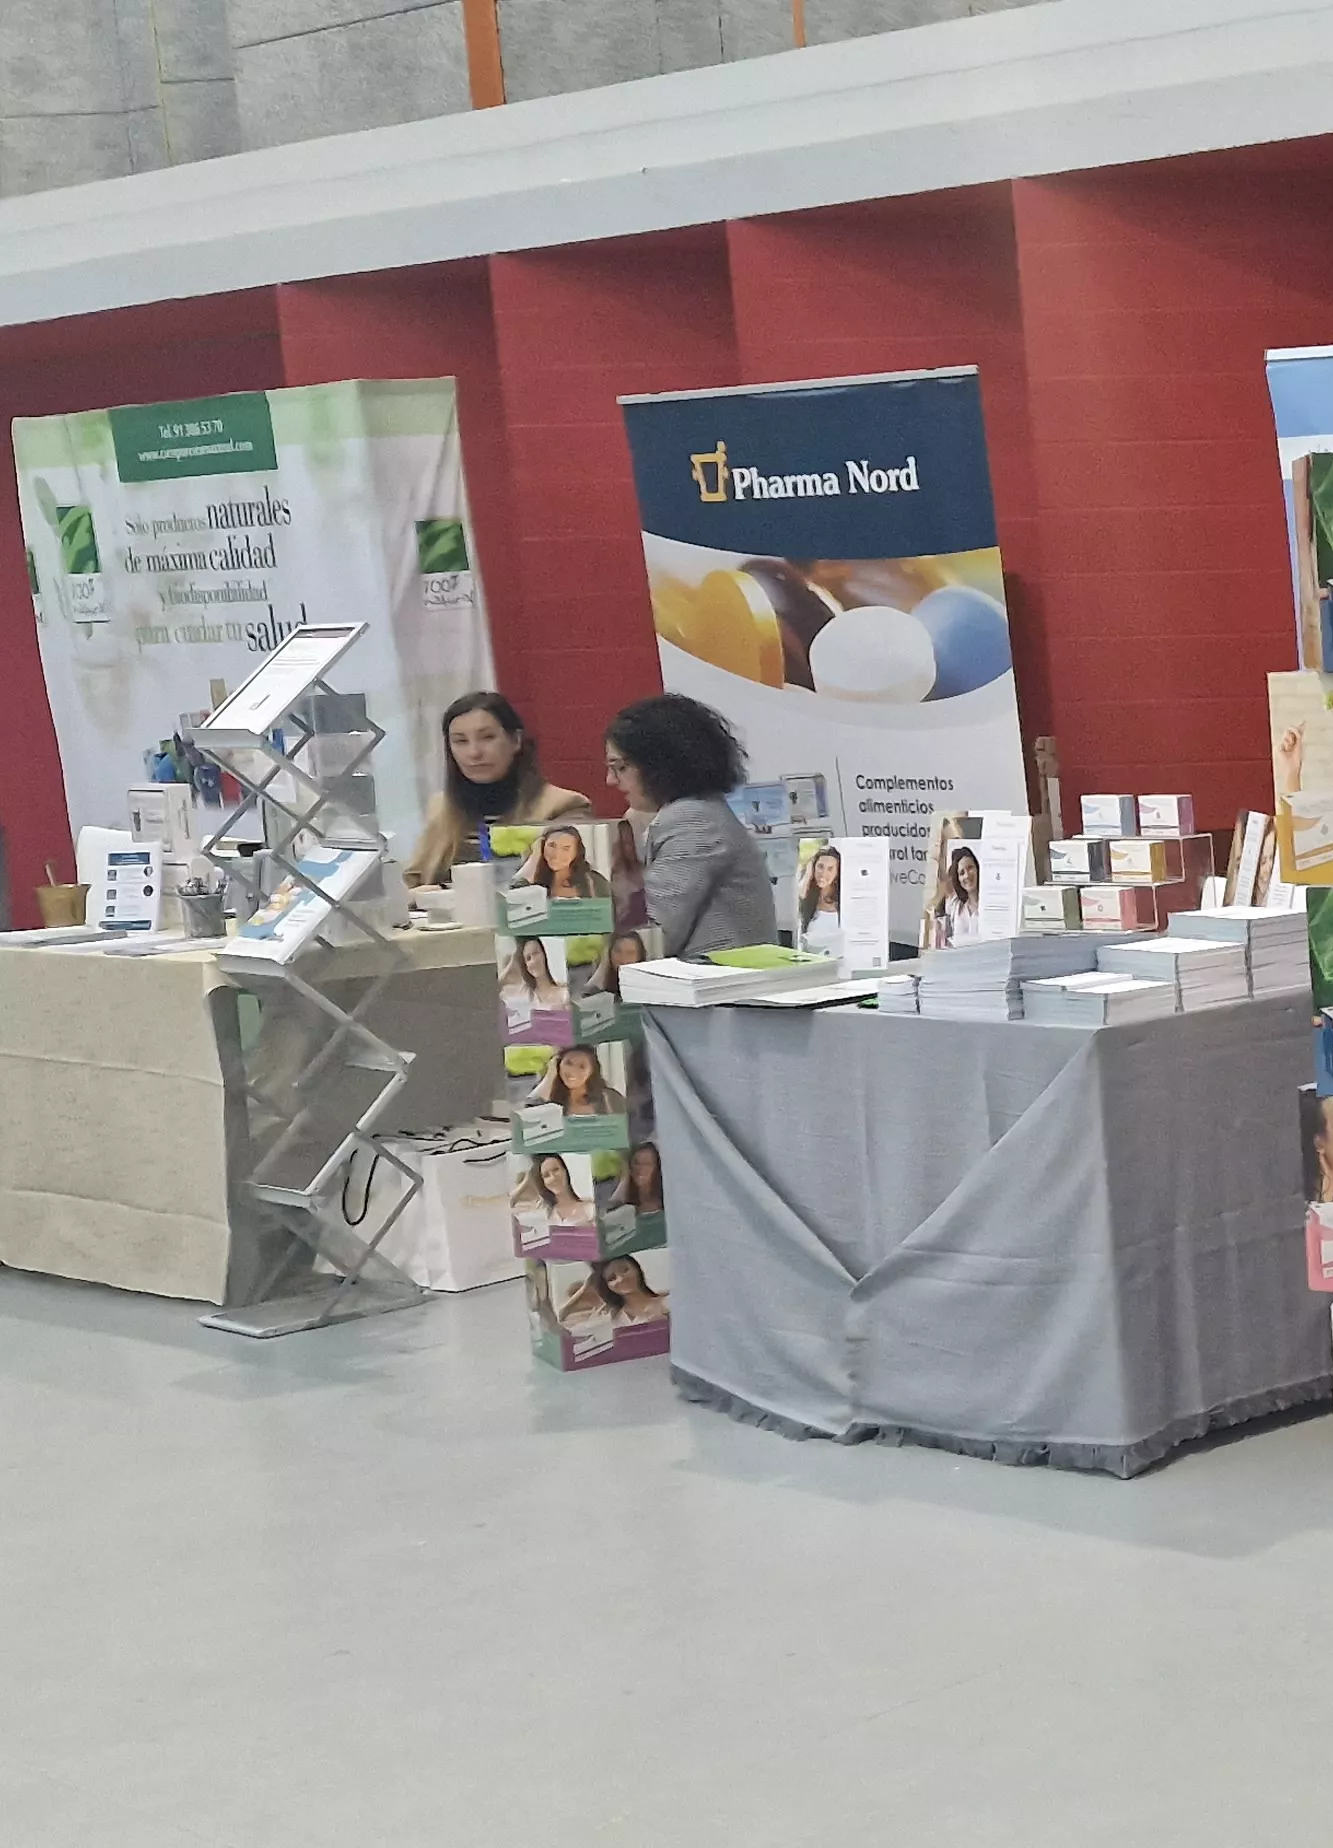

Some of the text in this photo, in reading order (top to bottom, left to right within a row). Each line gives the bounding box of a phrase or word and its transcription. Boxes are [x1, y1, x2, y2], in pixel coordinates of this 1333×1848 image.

[731, 456, 920, 500] Pharma Nord
[206, 485, 292, 530] naturales
[124, 532, 278, 574] de máxima calidad
[856, 773, 955, 793] Complementos
[858, 797, 935, 815] alimenticios
